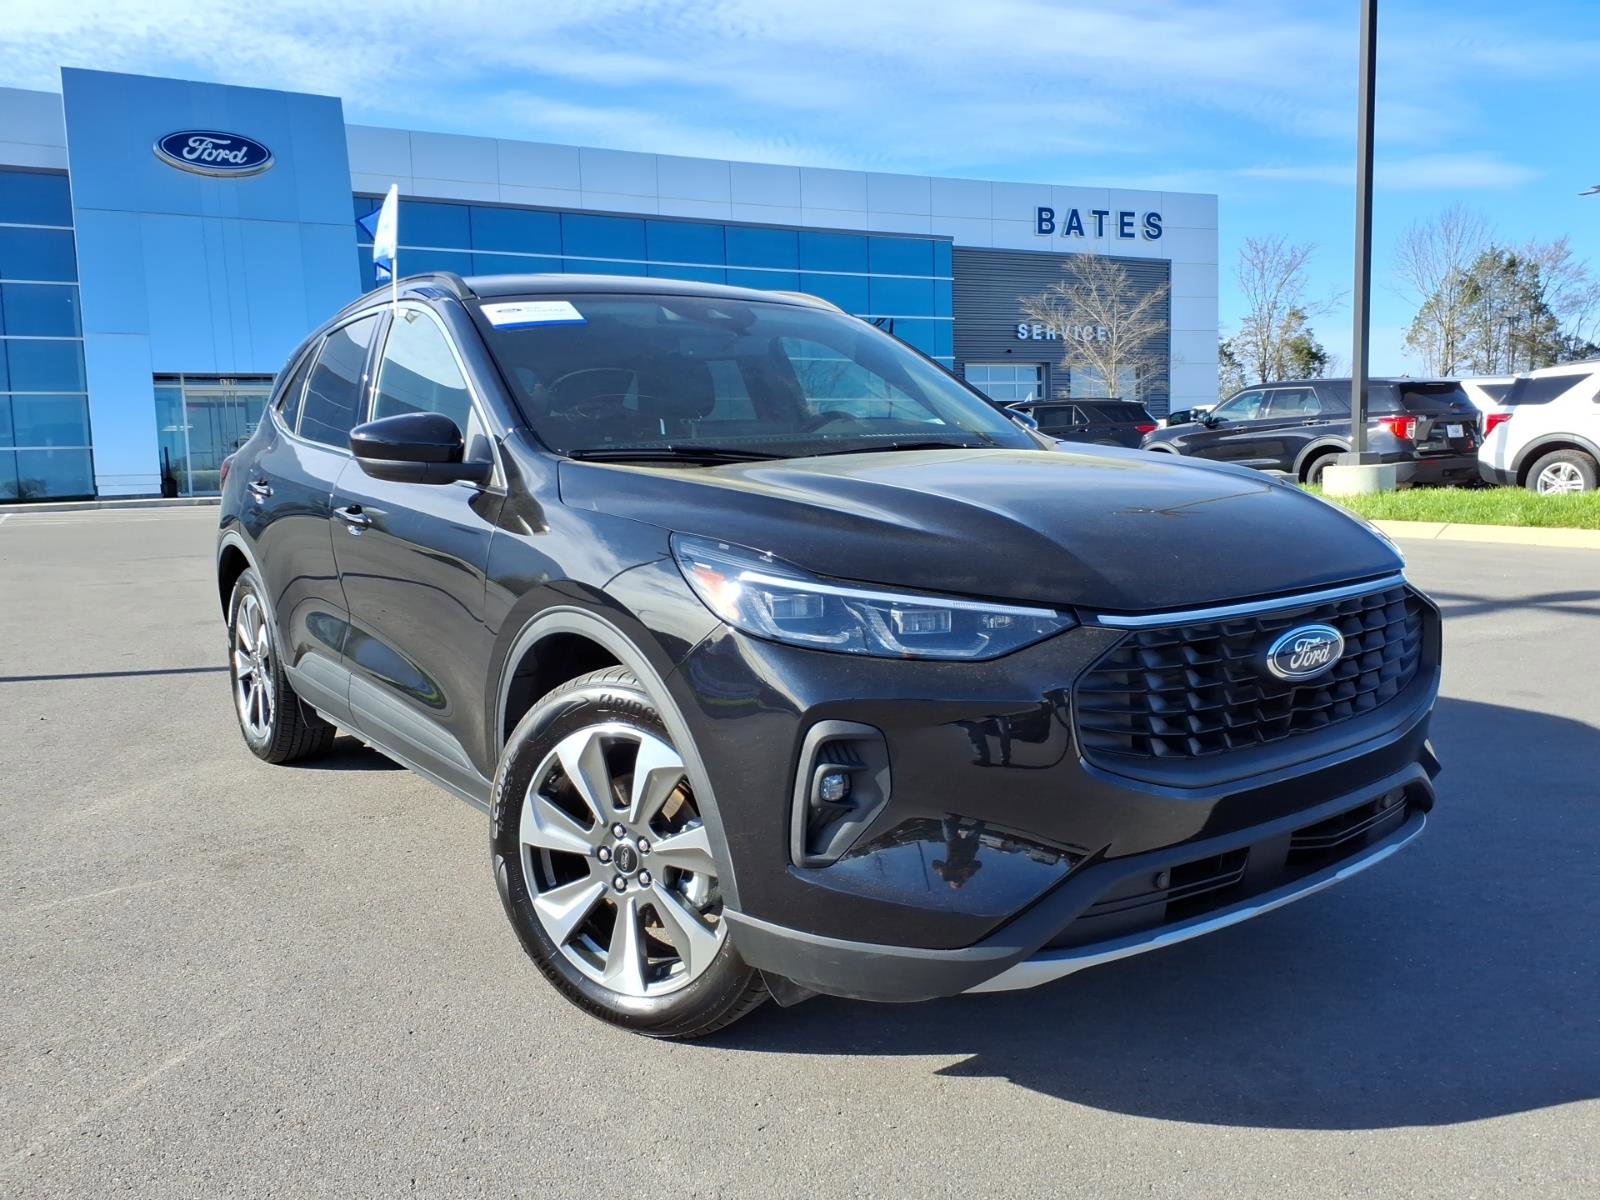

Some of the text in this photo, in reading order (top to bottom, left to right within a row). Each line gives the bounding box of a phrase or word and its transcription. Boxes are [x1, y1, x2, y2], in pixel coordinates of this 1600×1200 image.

[182, 136, 248, 163] Ford
[1036, 206, 1163, 240] BATES
[1017, 323, 1107, 341] SERVICE
[1290, 637, 1331, 669] Ford
